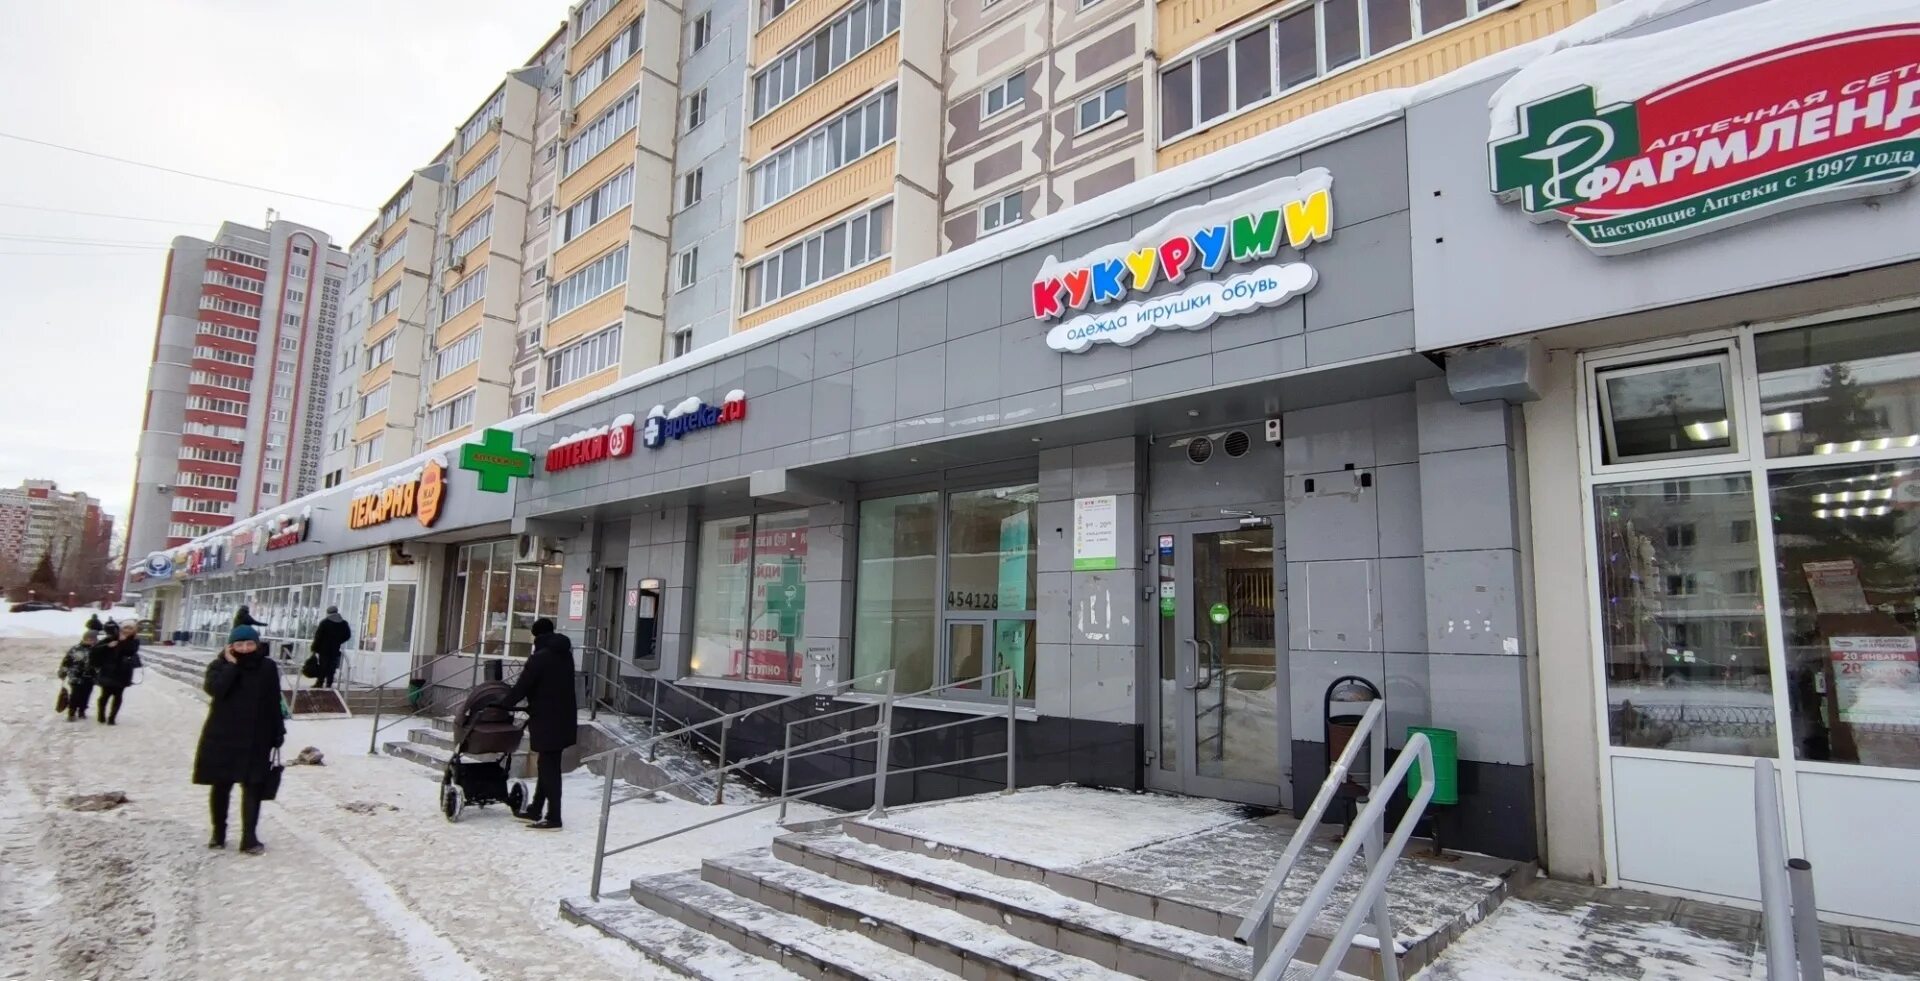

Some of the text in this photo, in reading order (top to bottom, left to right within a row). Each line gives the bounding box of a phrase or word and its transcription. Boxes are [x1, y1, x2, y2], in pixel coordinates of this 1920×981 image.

[1645, 63, 1920, 153] АПТЕЧНАЯ СЕТ
[1589, 149, 1915, 239] Настоящие Аптеки с 1997 года
[1032, 188, 1329, 319] КУКУРУМИ
[1067, 277, 1278, 341] одежда игрушки обувь
[664, 399, 746, 439] apteka.ru
[545, 434, 609, 472] АПТЕКИ
[349, 480, 417, 529] ПЕКАРНЯ
[948, 591, 998, 609] 454128
[1842, 652, 1906, 661] 20 ЯНВАРЯ
